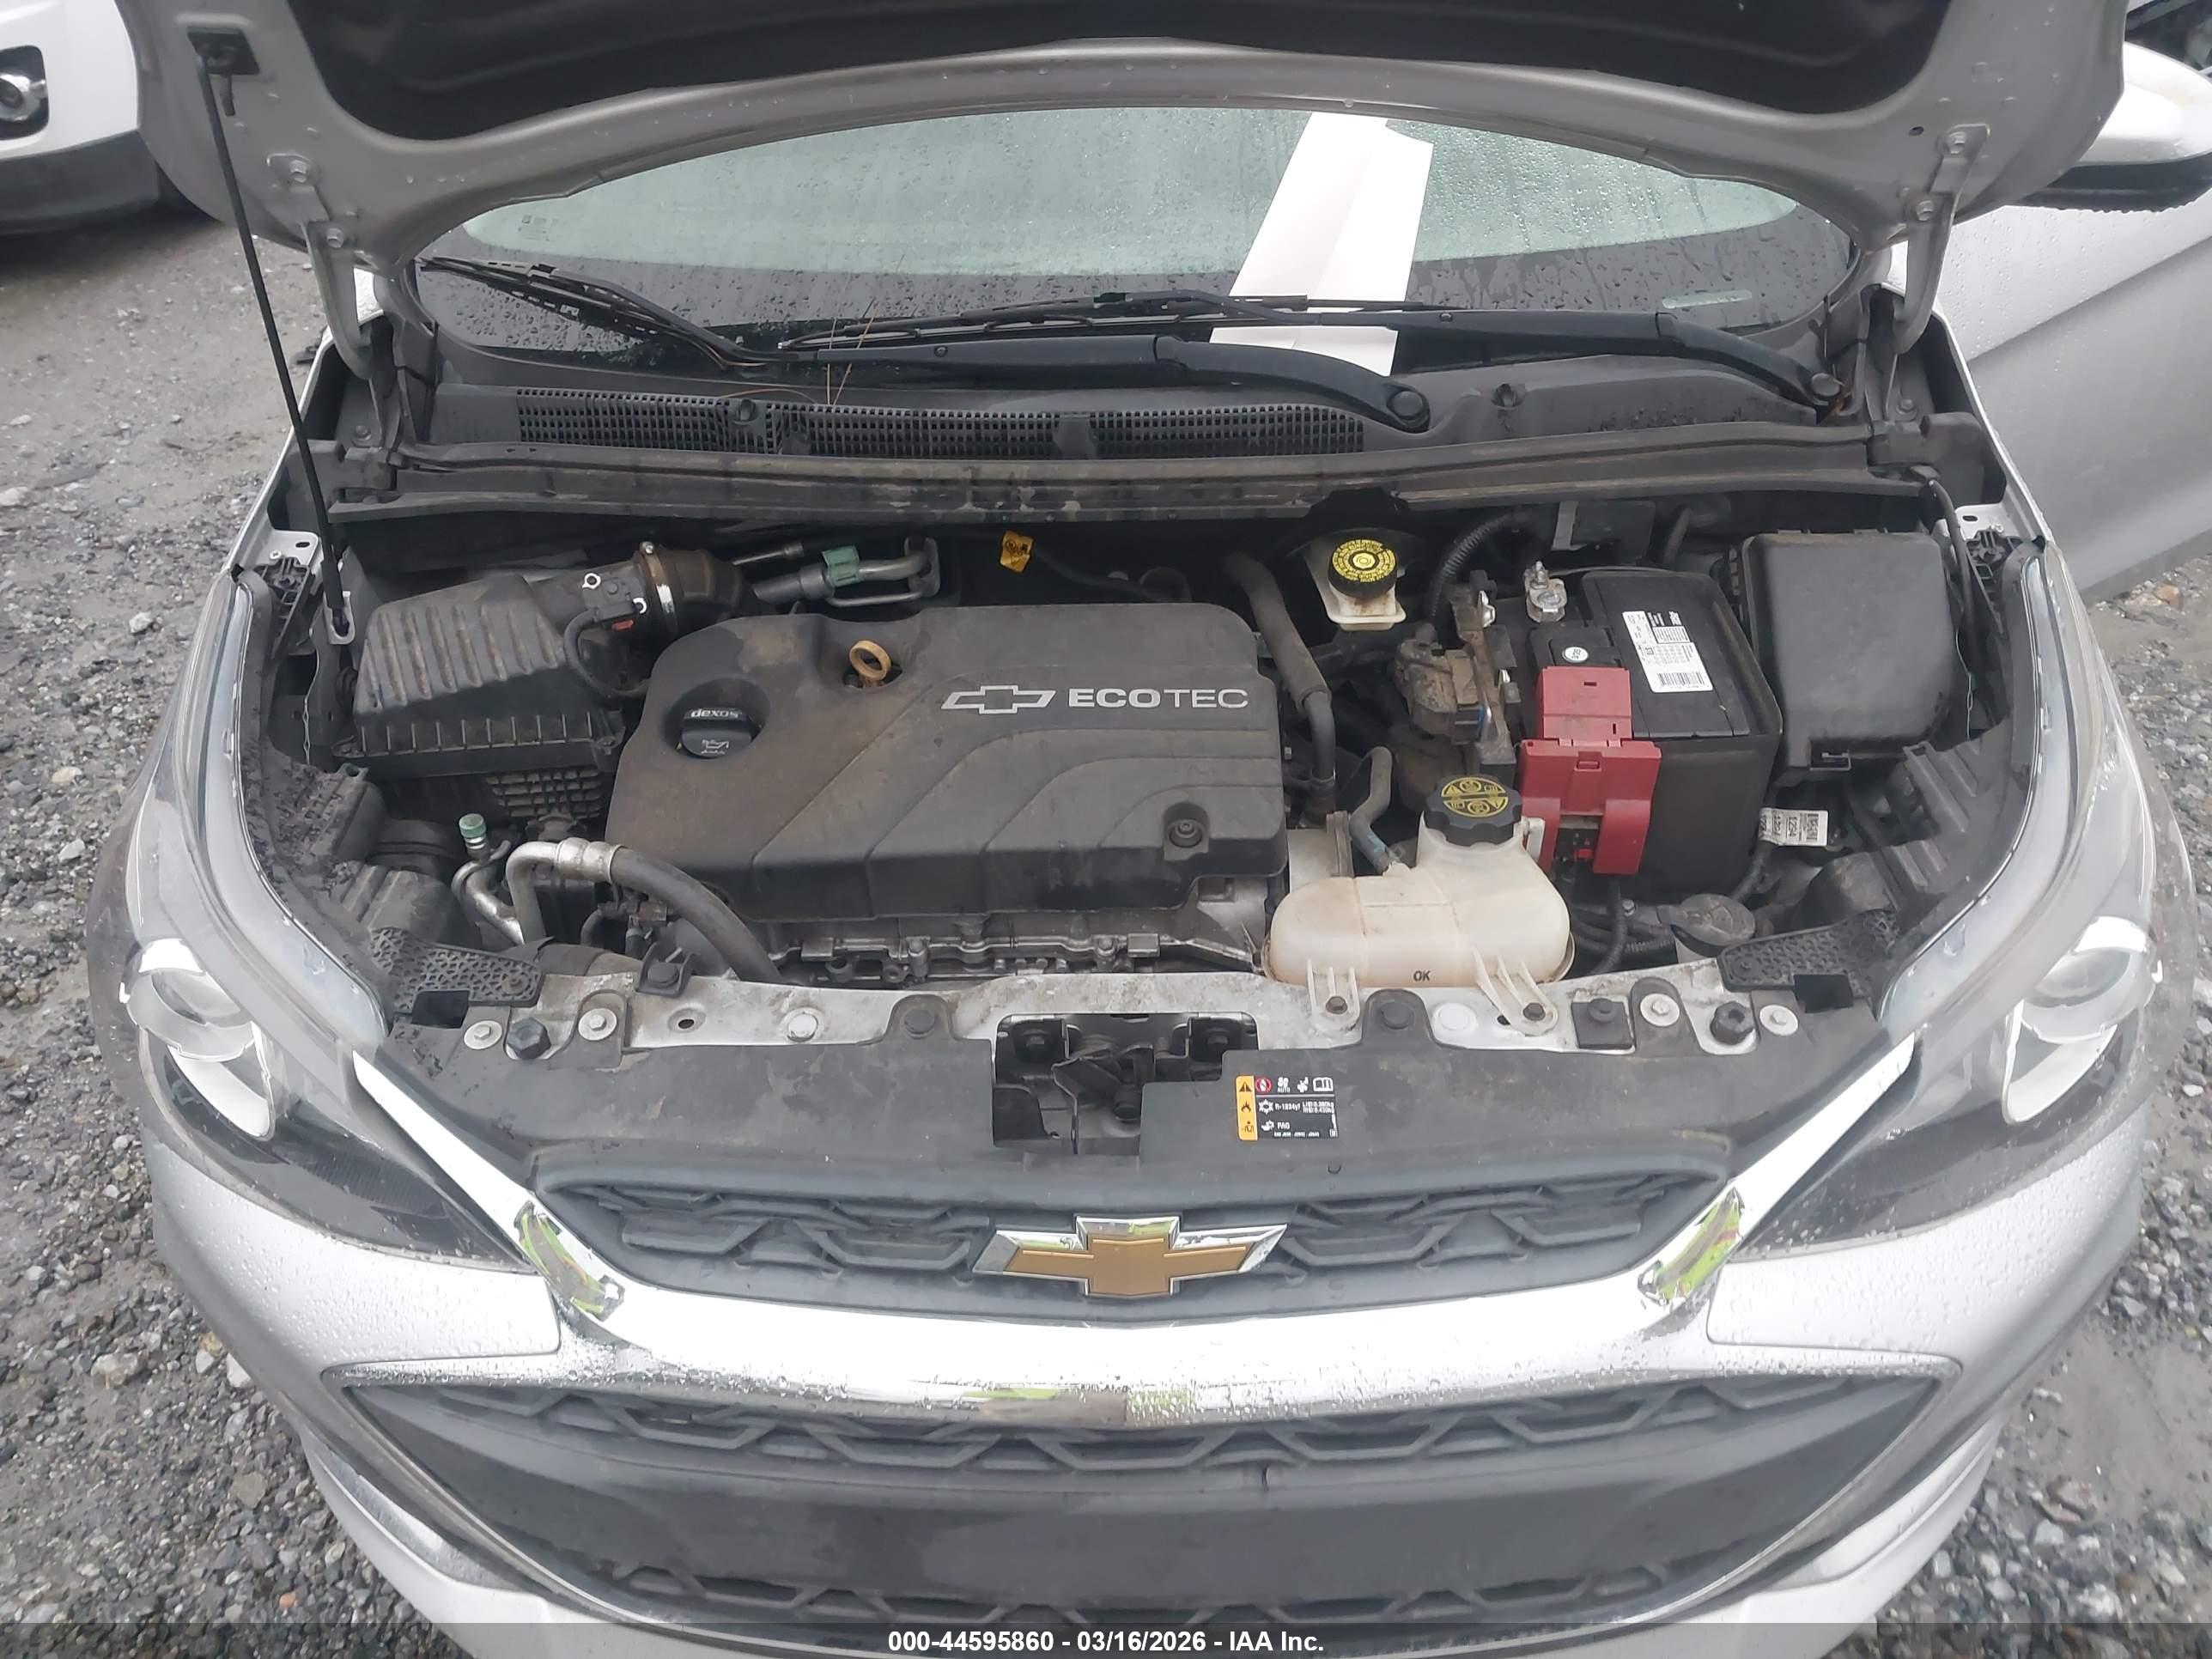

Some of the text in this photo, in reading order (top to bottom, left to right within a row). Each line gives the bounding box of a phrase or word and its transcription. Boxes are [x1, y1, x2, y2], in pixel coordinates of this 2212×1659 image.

[1068, 688, 1249, 708] ECOTEC
[1413, 970, 1431, 981] OK
[1277, 1121, 1291, 1130] PAG
